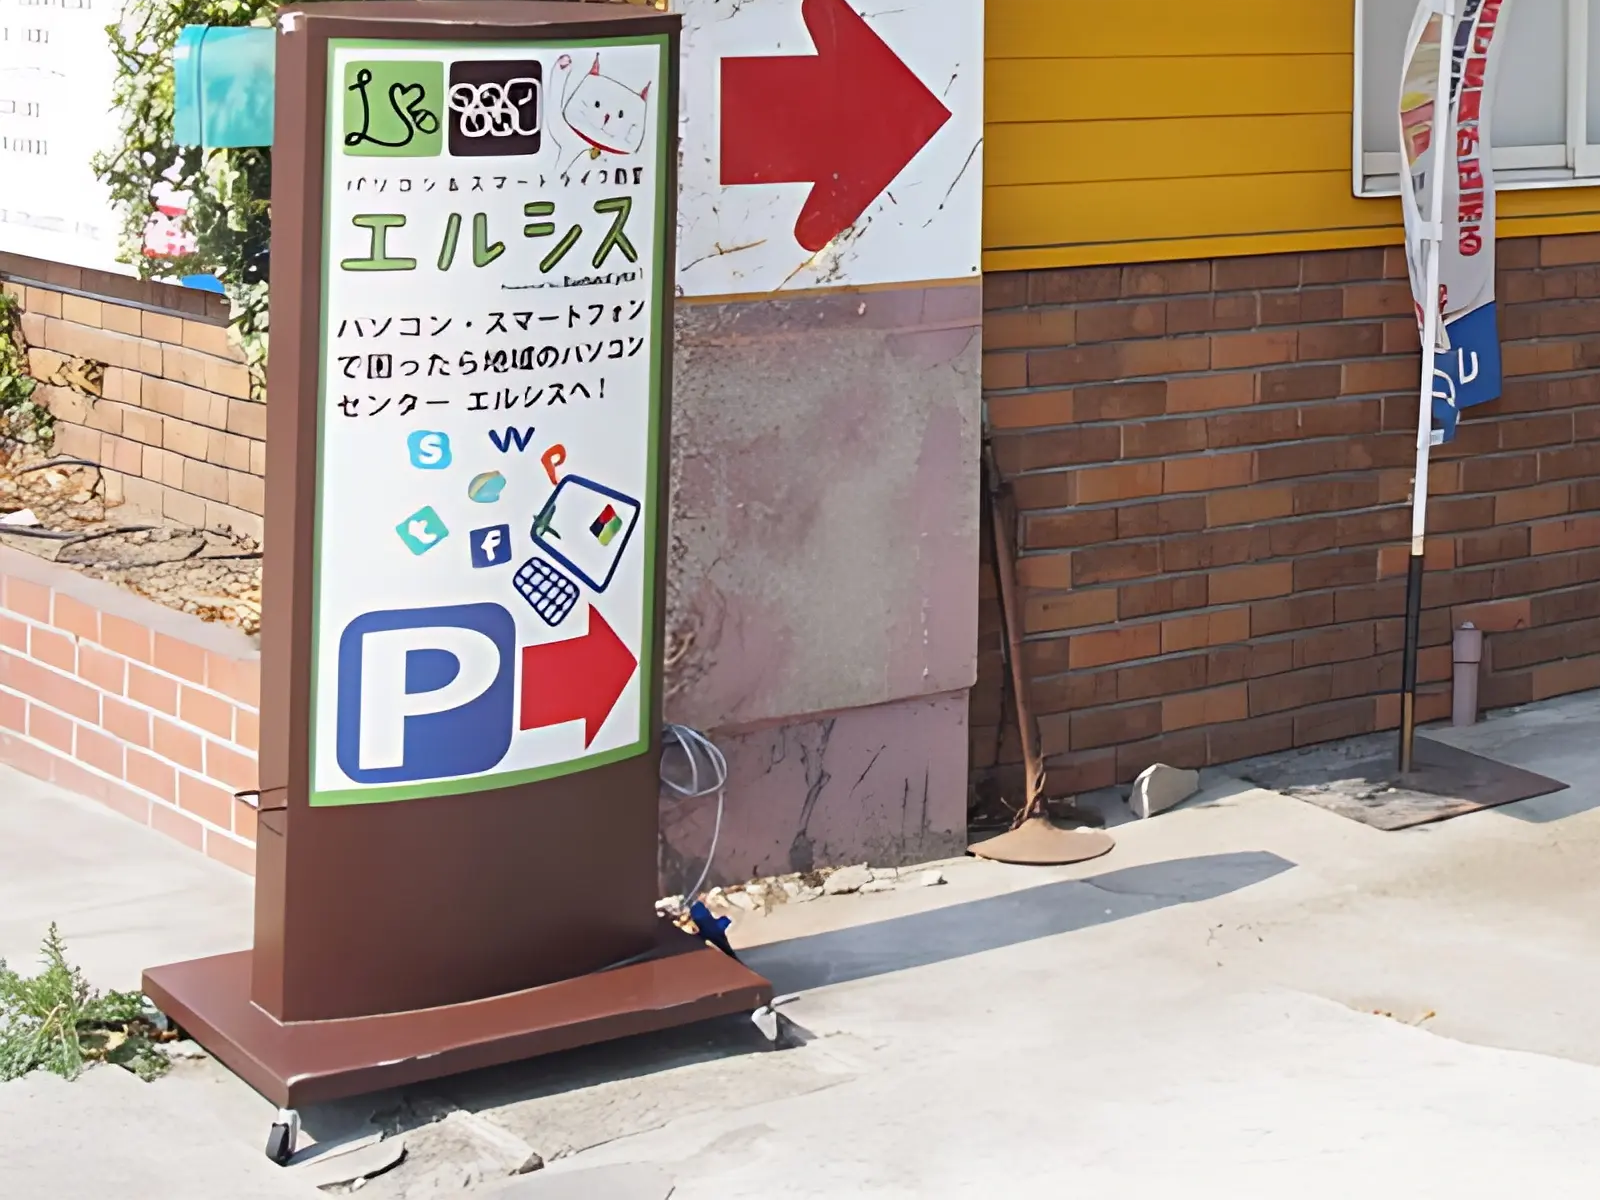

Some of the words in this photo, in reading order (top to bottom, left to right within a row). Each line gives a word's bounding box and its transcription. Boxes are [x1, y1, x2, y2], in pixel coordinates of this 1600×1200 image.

[340, 196, 639, 273] エルシス
[337, 391, 450, 417] センター
[358, 626, 501, 771] P
